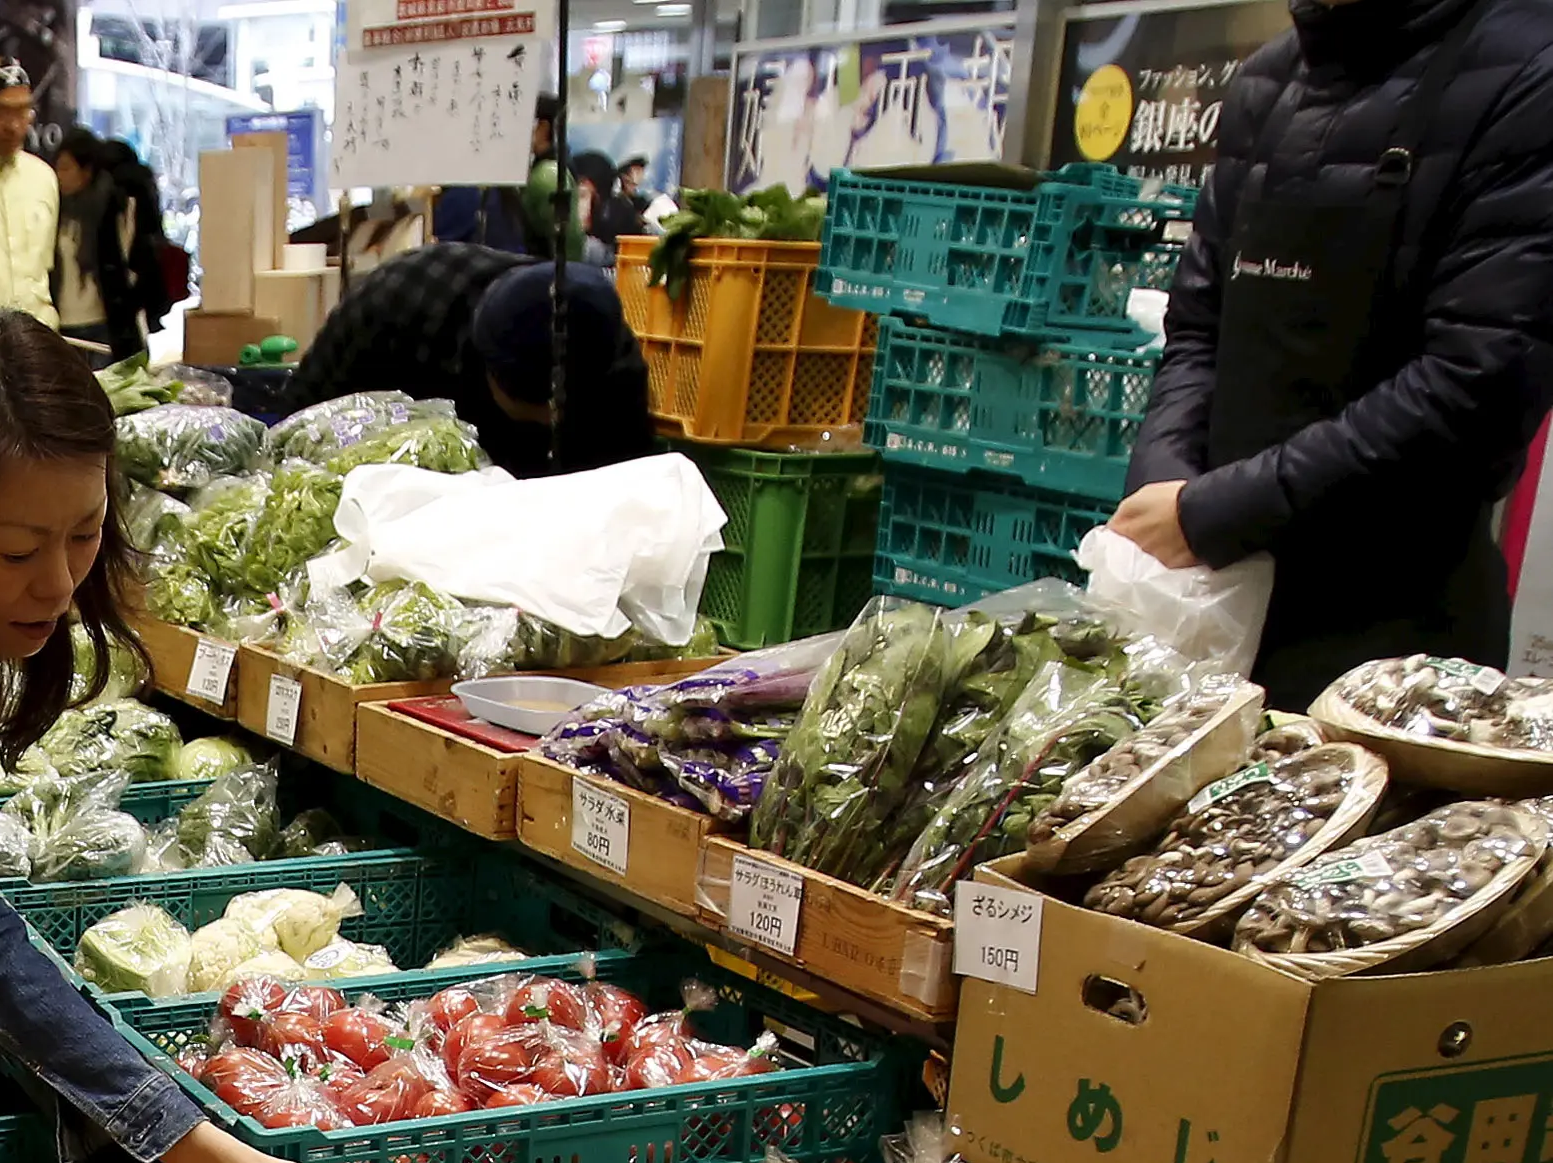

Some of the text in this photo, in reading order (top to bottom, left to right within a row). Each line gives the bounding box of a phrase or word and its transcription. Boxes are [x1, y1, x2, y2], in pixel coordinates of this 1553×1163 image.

[1139, 58, 1244, 90] ファッション、グ
[587, 831, 610, 857] 80円
[972, 895, 1033, 924] ざるシメジ
[750, 911, 782, 939] 120円
[981, 946, 1018, 973] 150円
